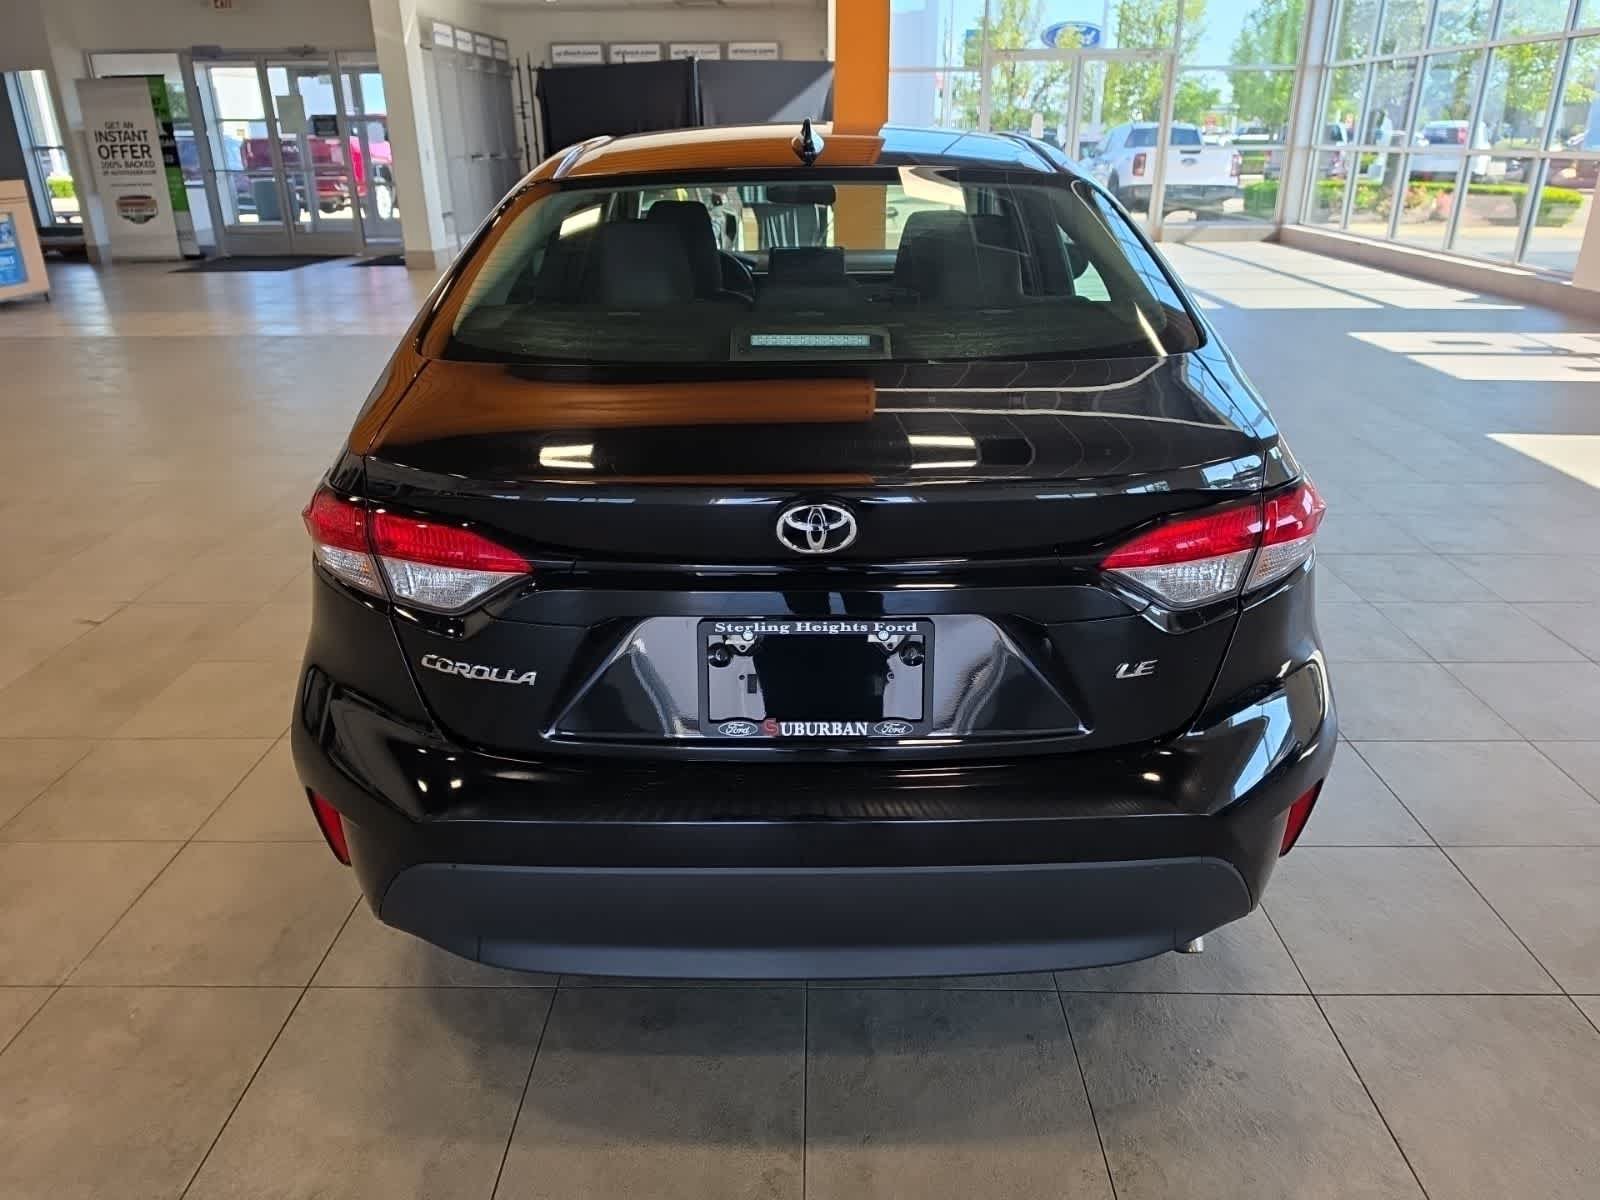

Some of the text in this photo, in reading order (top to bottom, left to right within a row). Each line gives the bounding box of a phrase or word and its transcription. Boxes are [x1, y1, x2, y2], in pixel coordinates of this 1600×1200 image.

[94, 130, 148, 143] INSTANT
[97, 144, 152, 160] OFFER
[714, 622, 918, 635] Sterling Heights Ford
[421, 654, 538, 686] COROLLA
[1115, 659, 1158, 679] LE
[763, 719, 868, 737] SUBURBAN
